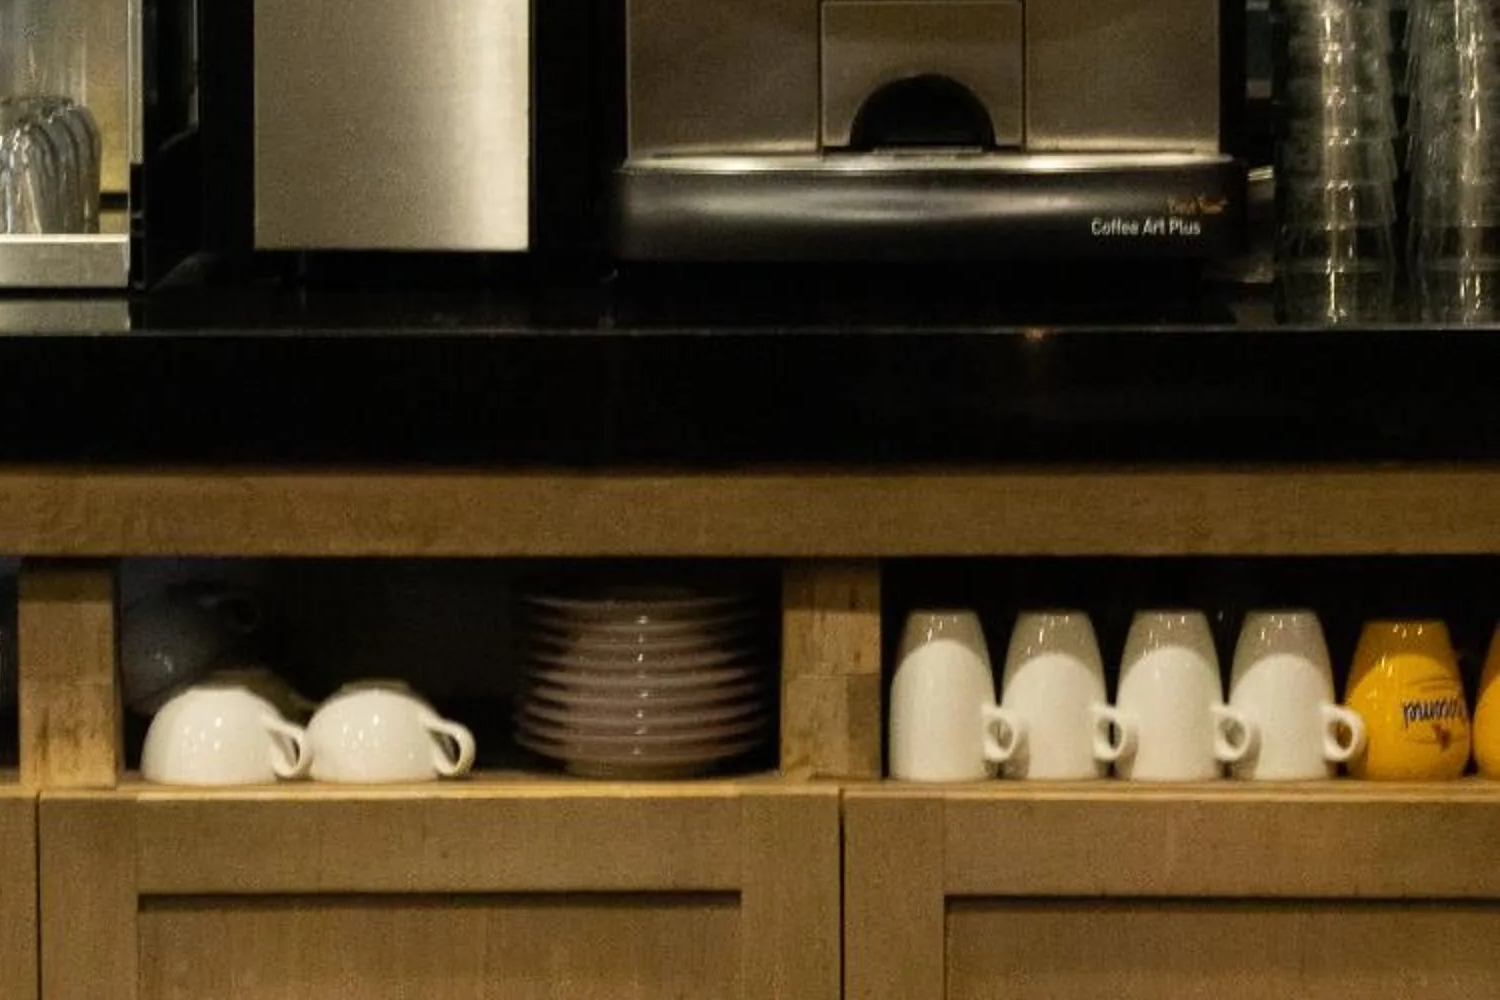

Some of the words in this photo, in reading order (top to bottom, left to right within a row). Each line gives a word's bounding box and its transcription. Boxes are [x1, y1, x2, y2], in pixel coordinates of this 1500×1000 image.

[1091, 217, 1139, 236] Coffee
[1142, 216, 1165, 236] Art
[1169, 217, 1201, 236] Plus
